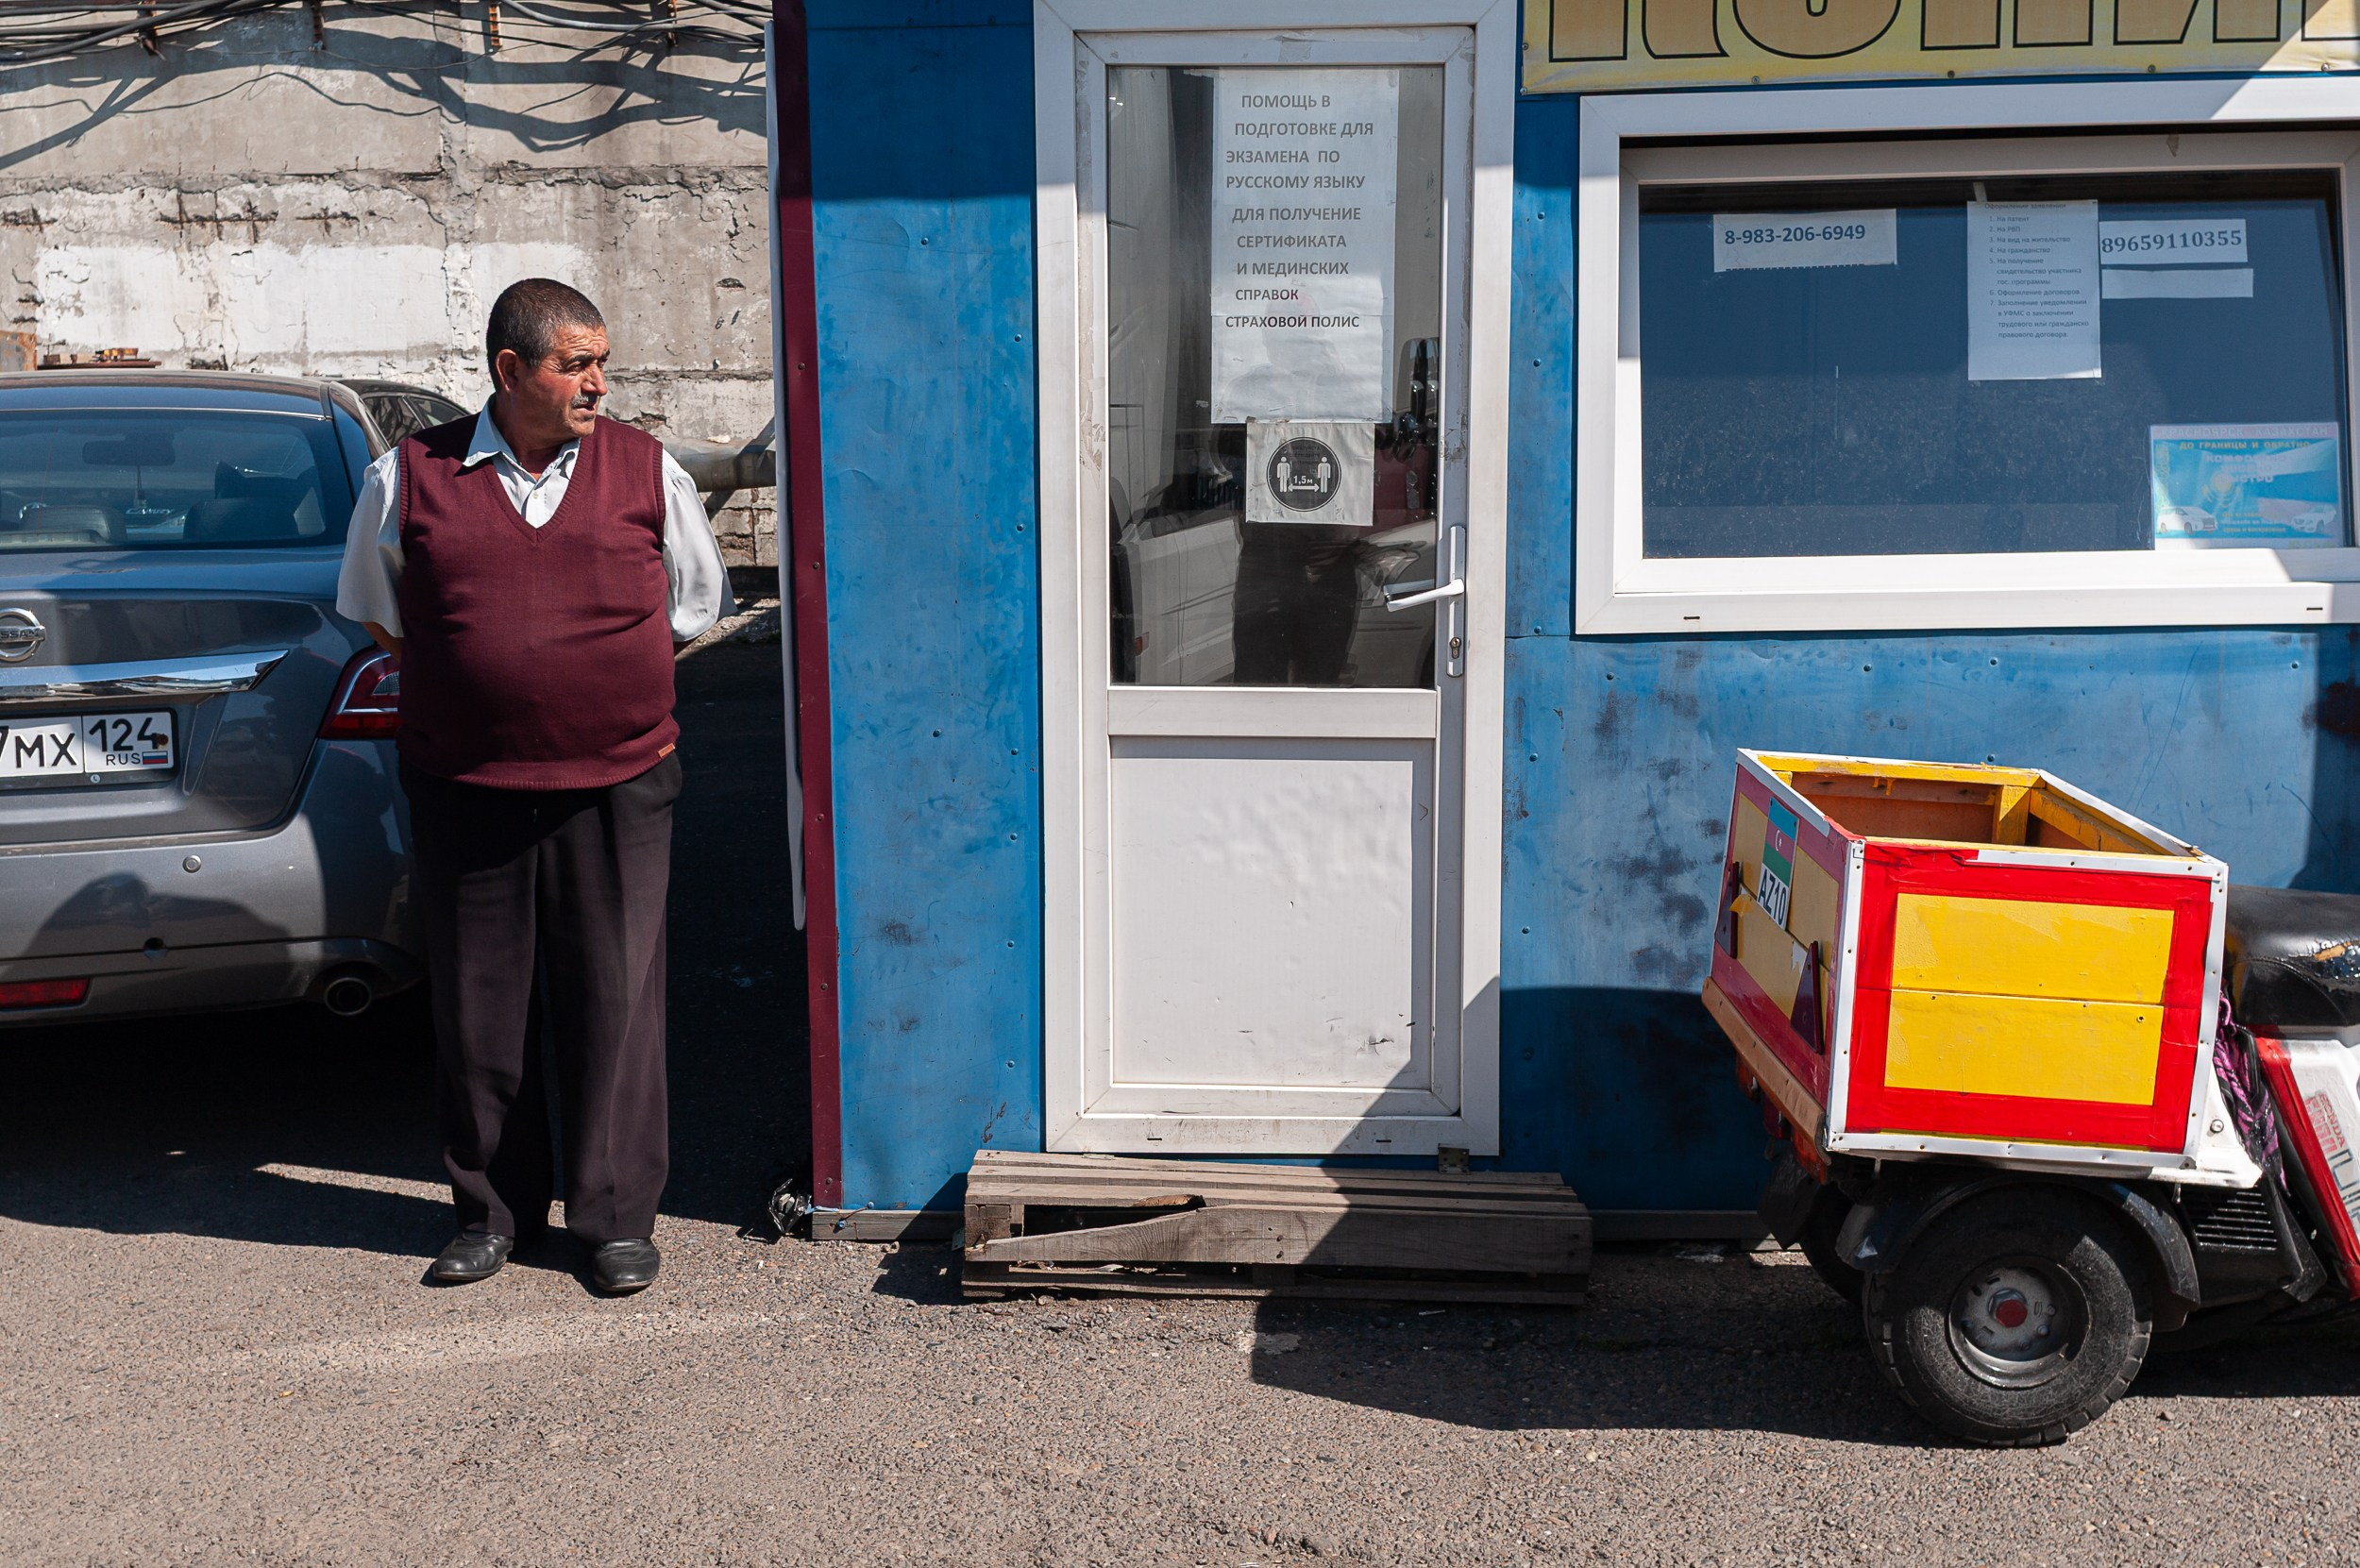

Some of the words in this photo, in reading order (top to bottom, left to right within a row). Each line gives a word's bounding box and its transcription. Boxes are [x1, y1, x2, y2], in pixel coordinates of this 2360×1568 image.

[1241, 94, 1317, 110] ПОМОЩЬ
[1322, 95, 1331, 108] В
[1235, 123, 1337, 138] ПОДГОТОВКЕ
[1340, 123, 1374, 138] ДЛЯ
[1226, 150, 1309, 163] ЭКЗАМЕНА
[1318, 150, 1340, 163] ПО
[1226, 176, 1309, 189] РУССКОМУ
[1313, 176, 1366, 189] ЯЗЫКУ
[1232, 208, 1264, 224] ДЛЯ
[1269, 208, 1361, 221] ПОЛУЧЕНИЕ
[1237, 235, 1347, 248] СЕРТИФИКАТА
[1725, 225, 1865, 244] 8-983-206-6949
[2101, 229, 2242, 254] 89659110355
[1237, 262, 1248, 275] И
[1252, 261, 1349, 278] МЕДИНСКИХ
[1235, 289, 1299, 301] СПРАВОК
[1225, 315, 1306, 328] СТРАХОВОЙ
[1311, 316, 1359, 328] ПОЛИС
[2180, 441, 2195, 450] ДО
[2200, 441, 2247, 450] ГРАНИЦЫ
[89, 717, 160, 752] 124
[106, 753, 141, 766] RUS
[1758, 868, 1787, 926] AZ10
